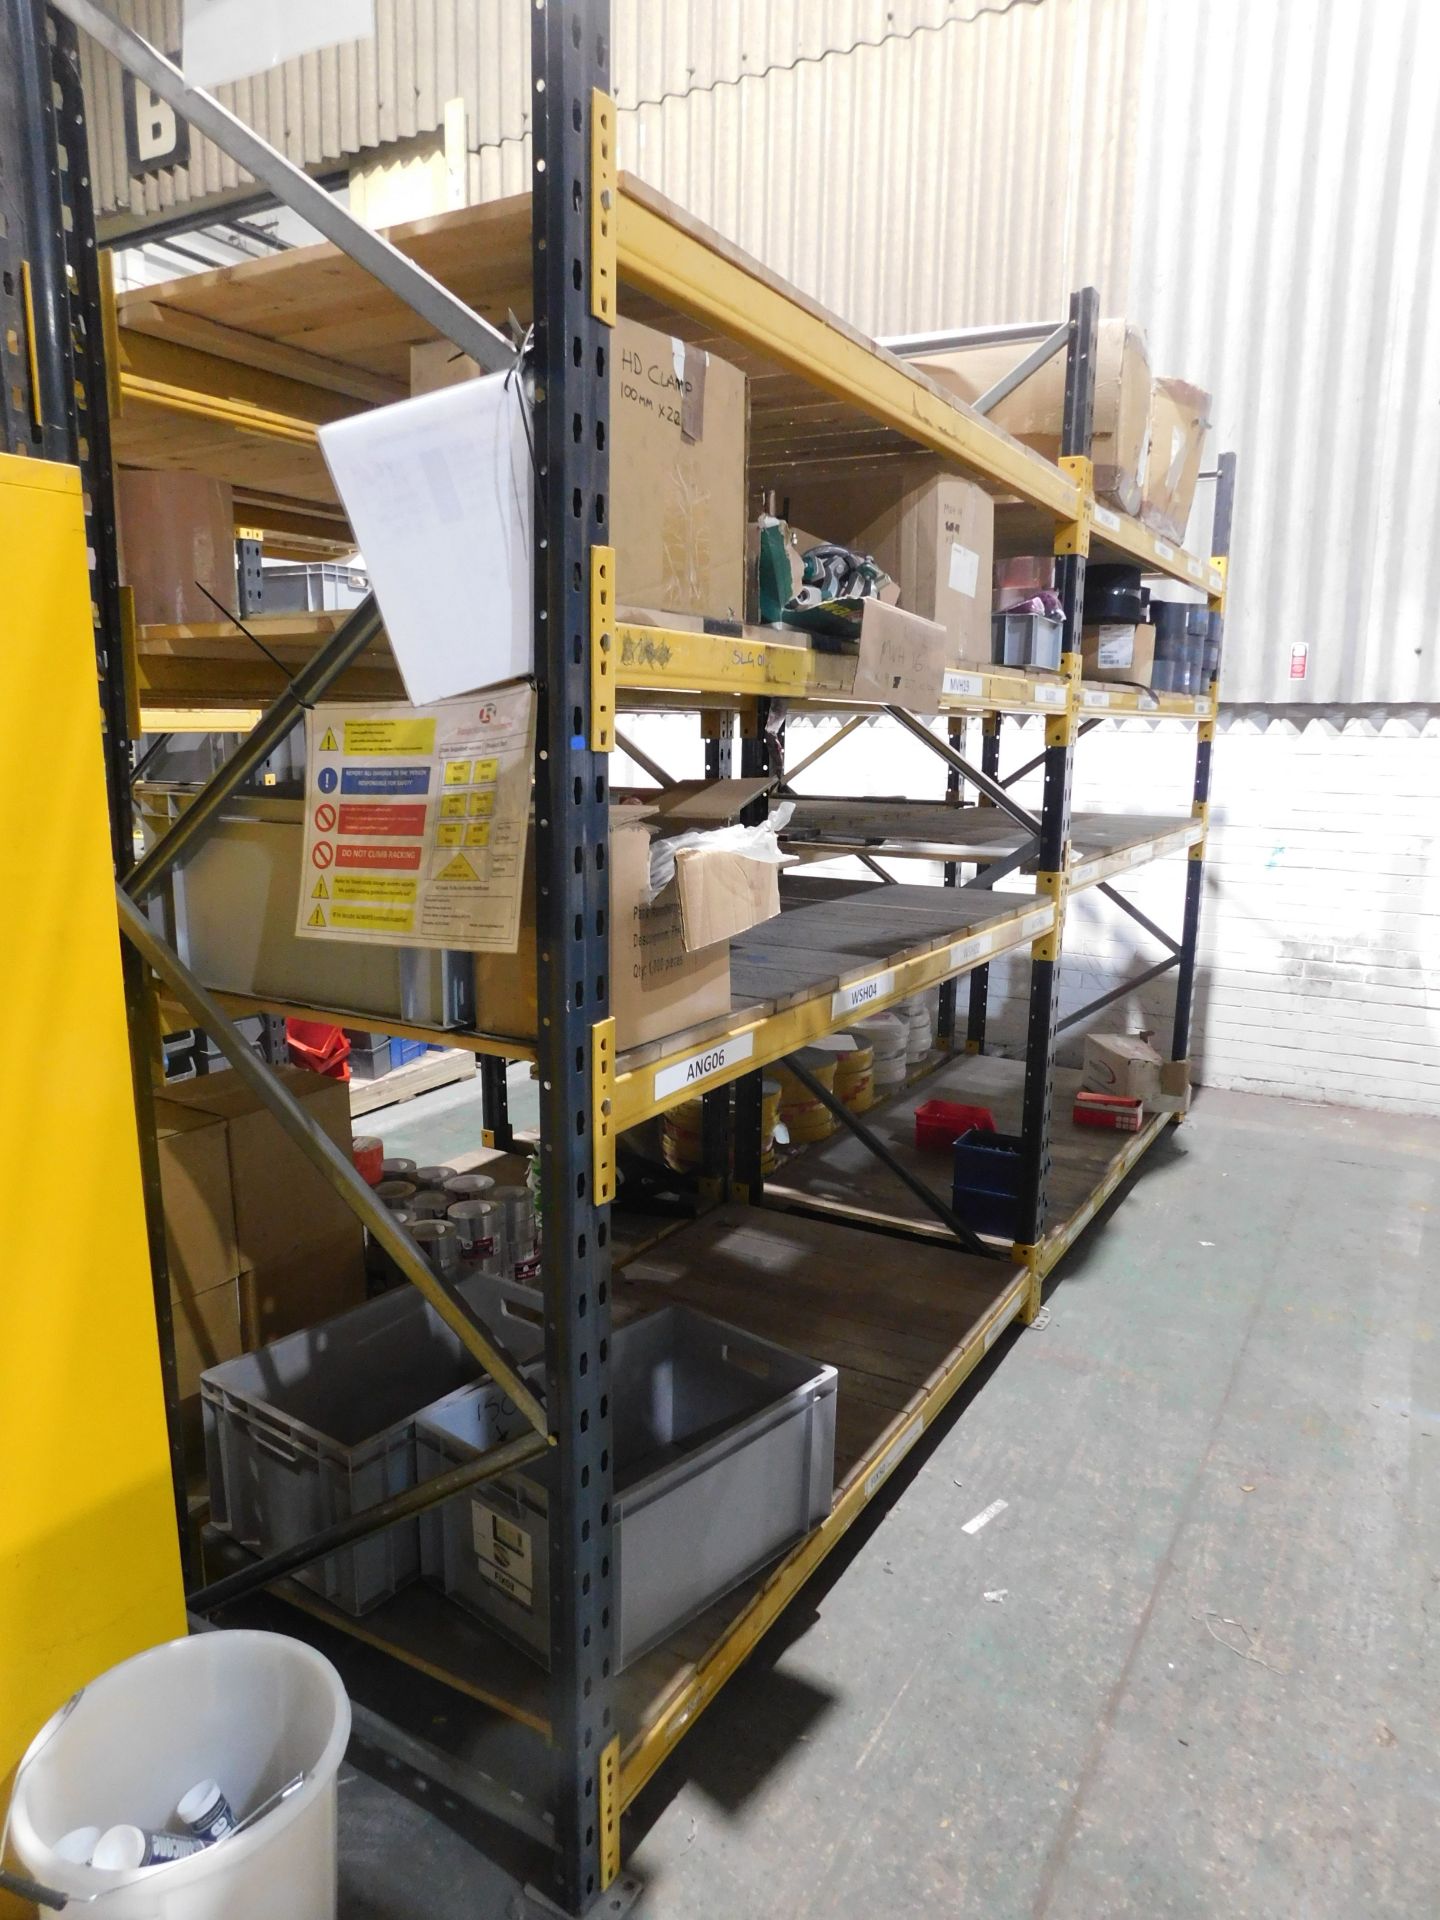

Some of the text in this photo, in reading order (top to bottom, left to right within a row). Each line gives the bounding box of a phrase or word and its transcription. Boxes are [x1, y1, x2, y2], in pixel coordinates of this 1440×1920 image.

[621, 348, 643, 376] HD
[342, 849, 416, 860] DO NOT CLIMB RACKING
[851, 983, 877, 1006] WSH04
[686, 1049, 725, 1082] ANG06
